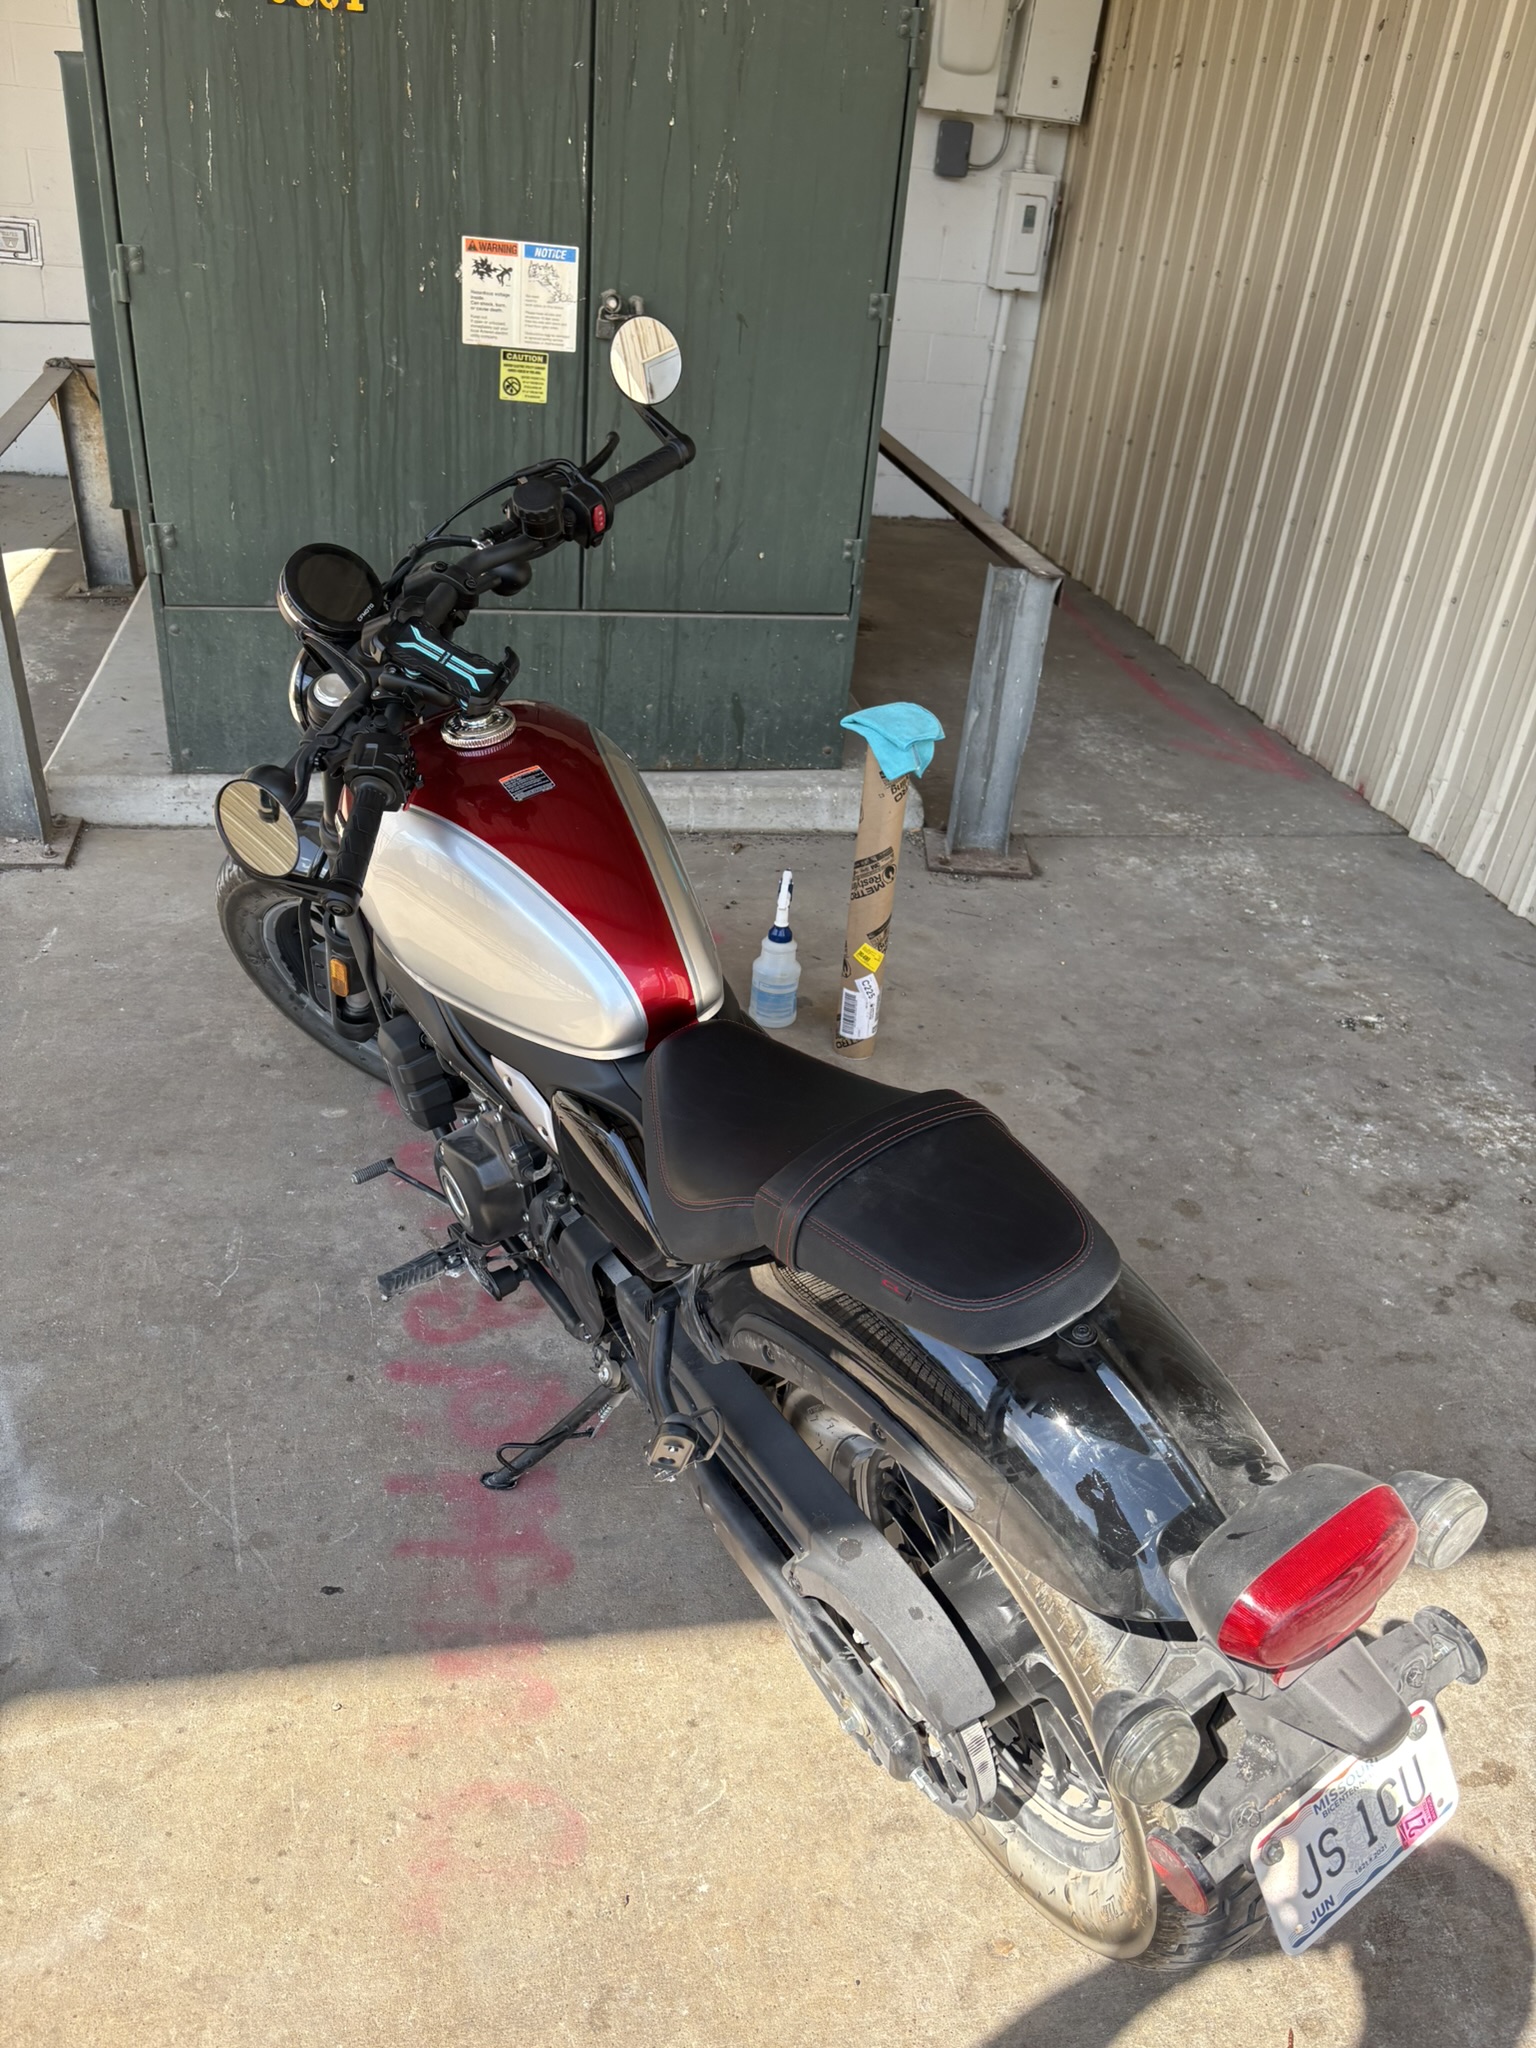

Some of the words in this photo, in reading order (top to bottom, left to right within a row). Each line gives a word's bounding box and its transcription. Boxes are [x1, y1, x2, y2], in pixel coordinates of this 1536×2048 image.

[479, 241, 517, 255] WARNING
[534, 247, 567, 260] NOTICE
[506, 352, 543, 363] CAUTION
[357, 603, 375, 622] CFMOTO
[861, 979, 876, 1000] C225
[1302, 1827, 1346, 1900] JS
[1357, 1753, 1426, 1848] 1CU
[1354, 1857, 1368, 1875] 1821
[1373, 1843, 1388, 1860] 2021
[1310, 1895, 1336, 1925] JUN
